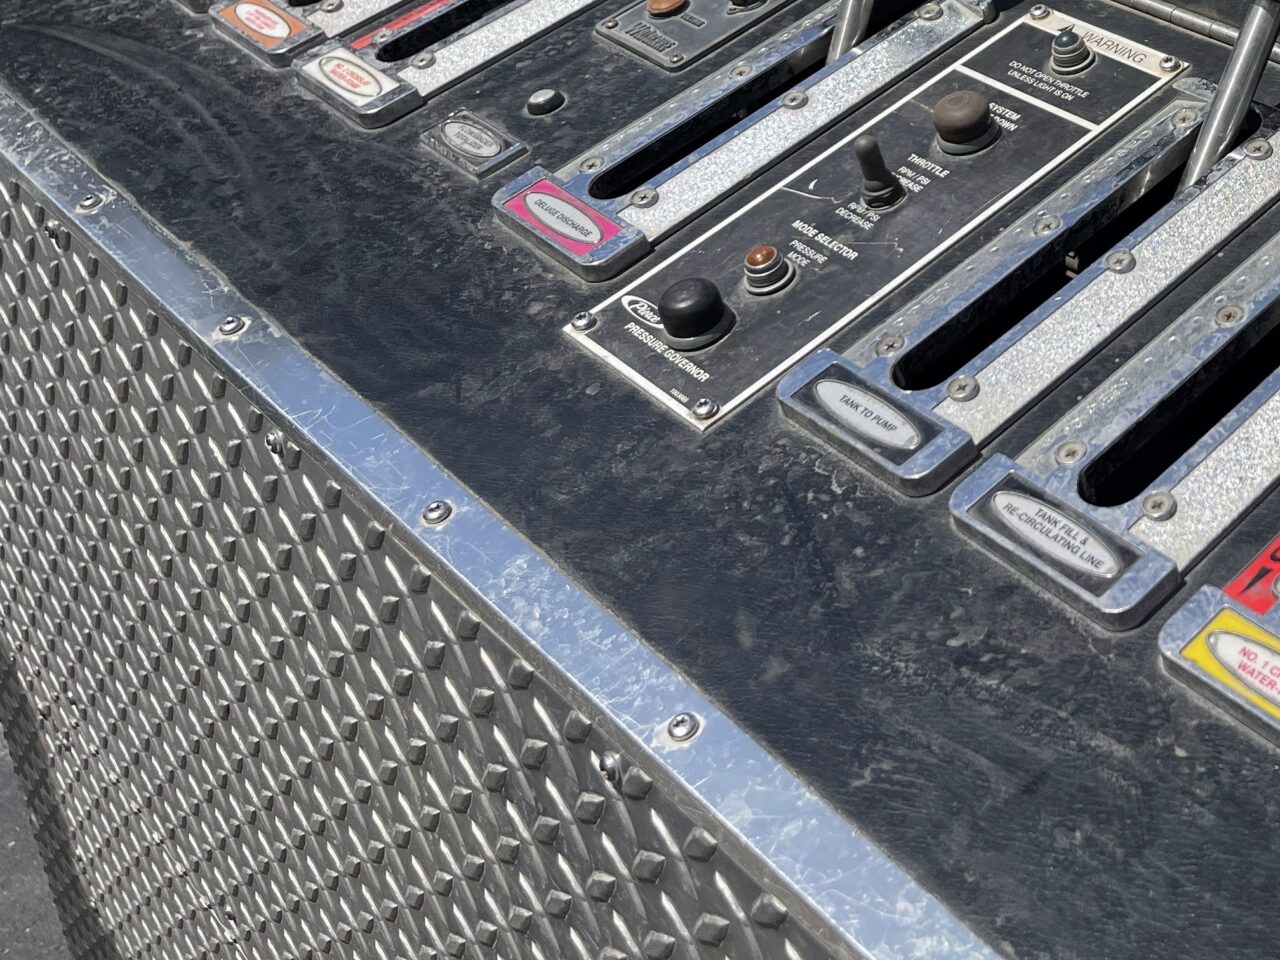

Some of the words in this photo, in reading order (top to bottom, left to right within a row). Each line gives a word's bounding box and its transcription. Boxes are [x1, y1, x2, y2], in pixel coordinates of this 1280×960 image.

[1082, 31, 1147, 64] WARNING
[1007, 69, 1034, 85] UNLESS
[1034, 80, 1054, 94] LIGHT
[1053, 89, 1062, 97] IS
[1062, 92, 1075, 101] ON
[1009, 60, 1019, 68] DO
[1020, 65, 1034, 77] NOT
[1033, 70, 1053, 84] OPEN
[1053, 79, 1090, 98] THROTTLE
[989, 102, 1021, 121] SYSTEM
[898, 166, 913, 179] RPM
[917, 175, 931, 185] PSI
[907, 153, 950, 179] THROTTLE
[534, 198, 561, 215] DELUGE
[556, 211, 593, 238] DISCHARGE
[835, 207, 875, 231] DECREASE
[789, 240, 829, 264] PRESSURE
[791, 220, 818, 238] MODE
[815, 232, 859, 261] SELECTOR
[786, 251, 811, 267] MODE
[624, 322, 667, 355] PRESSURE
[664, 350, 710, 383] GOVERNOR
[838, 393, 863, 413] TANK
[859, 405, 874, 419] TO
[869, 411, 898, 433] PUMP
[1001, 501, 1082, 559] RE-CIRCULATING
[1076, 548, 1105, 569] LINE
[1034, 506, 1060, 530] TANK
[1055, 519, 1079, 540] FILL
[1078, 534, 1089, 547] &
[1238, 646, 1258, 663] NO.
